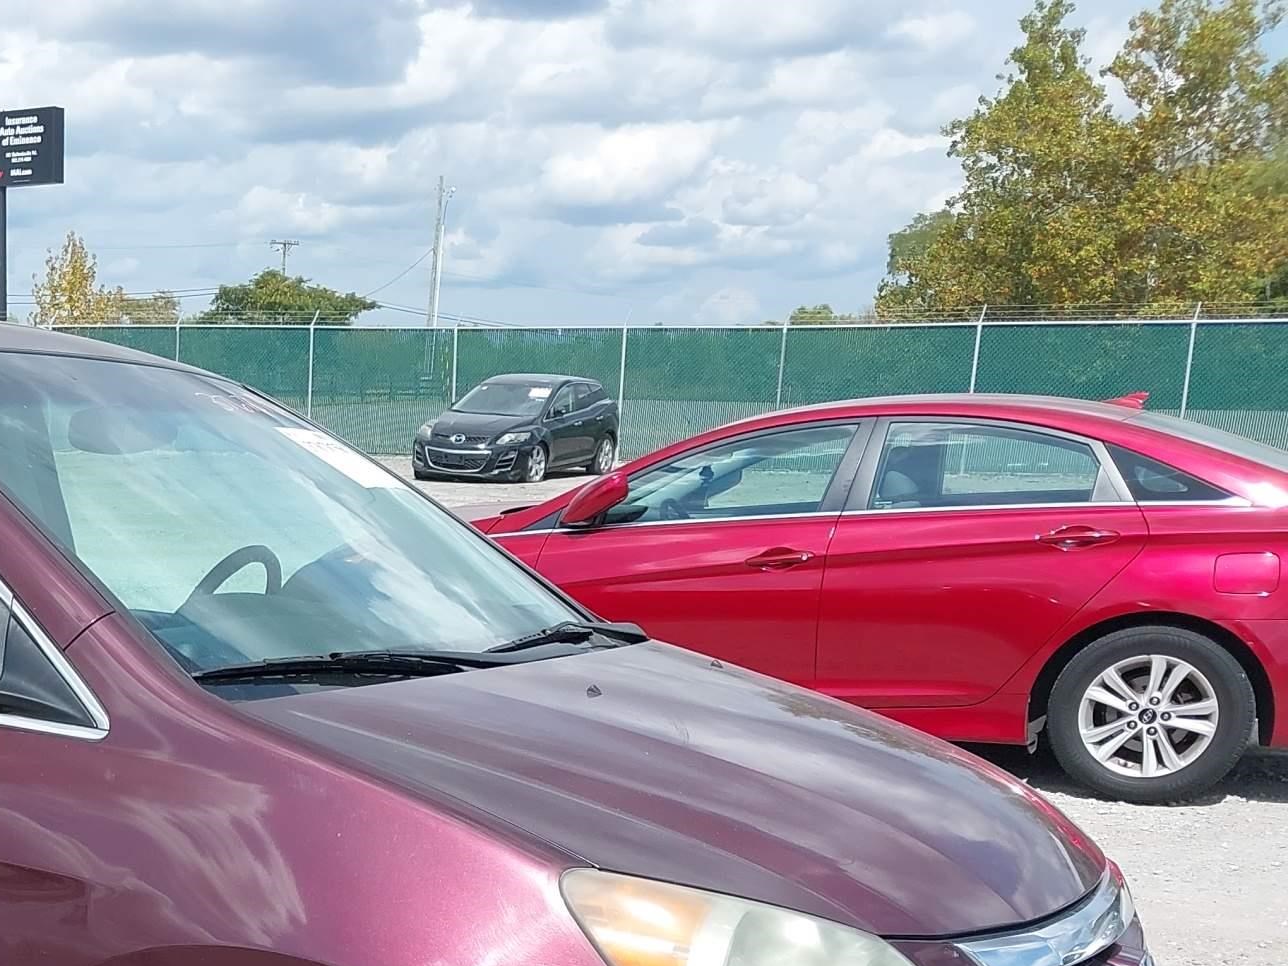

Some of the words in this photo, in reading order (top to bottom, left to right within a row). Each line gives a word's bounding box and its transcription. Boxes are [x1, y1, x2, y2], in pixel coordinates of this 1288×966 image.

[0, 126, 15, 137] Auto
[15, 124, 44, 135] Auctions
[1, 136, 9, 146] of
